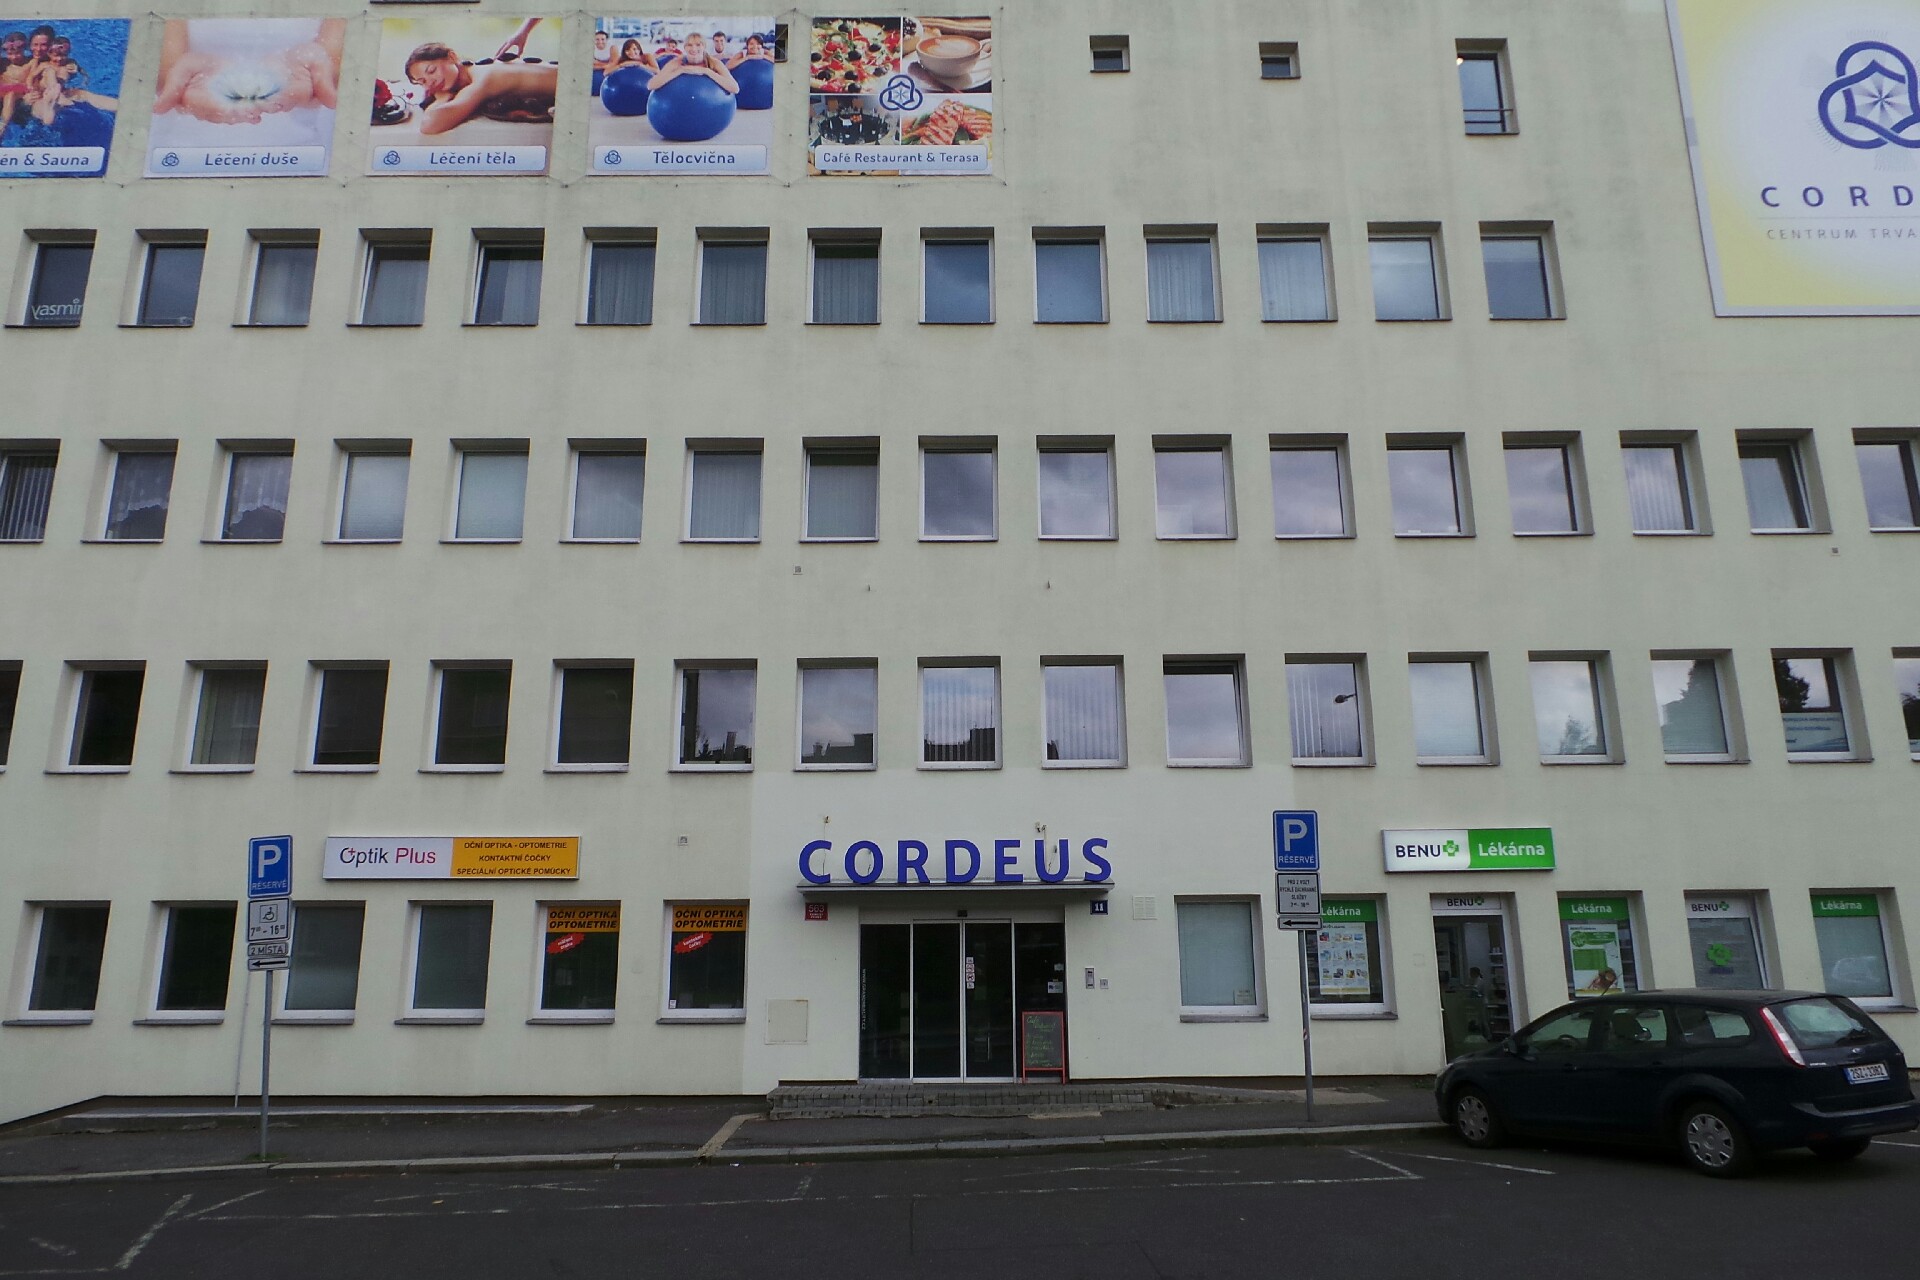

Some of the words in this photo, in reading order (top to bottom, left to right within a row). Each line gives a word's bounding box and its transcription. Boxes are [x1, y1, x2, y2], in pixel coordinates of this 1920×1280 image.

[24, 153, 36, 166] &
[40, 153, 90, 166] Sauna
[204, 152, 256, 166] Léčení
[261, 152, 299, 166] duše
[430, 152, 481, 165] Léčení
[487, 152, 516, 165] těla
[652, 151, 735, 164] Tělocvična
[823, 152, 851, 163] Café
[855, 152, 923, 163] Restaurant
[926, 152, 935, 162] &
[939, 152, 979, 163] Terasa
[1760, 185, 1914, 208] CORD
[1767, 229, 1857, 240] CENTRUM
[1283, 818, 1308, 852] P
[464, 841, 483, 849] OČNÍ
[484, 841, 513, 849] OPTIKA
[518, 841, 568, 849] OPTOMETRIE
[1395, 844, 1441, 858] BENU
[1478, 841, 1546, 857] Lékárna
[258, 844, 282, 879] P
[340, 847, 389, 868] Optik
[395, 847, 436, 864] Plus
[478, 854, 523, 862] KONTAKTNÍ
[524, 854, 551, 862] ČOČKY
[798, 837, 1112, 884] CORDEUS
[1278, 855, 1315, 864] RÉSERVÉ
[457, 867, 497, 875] SPECIÁLNÍ
[498, 867, 531, 875] OPTICKÉ
[251, 879, 288, 890] RÉSERVÉ
[1095, 902, 1104, 912] 11
[1447, 898, 1474, 907] BENU
[1691, 903, 1719, 912] BENU
[1820, 900, 1863, 910] Lékárna
[675, 909, 702, 918] OČNÍ
[704, 910, 744, 918] OPTIKA
[1320, 906, 1361, 916] Lékárna
[1571, 903, 1613, 914] Lékárna
[578, 910, 618, 919] OPTIKA
[549, 920, 618, 929] OPTOMETRIE
[675, 920, 744, 928] OPTOMETRIE
[250, 947, 256, 955] 2
